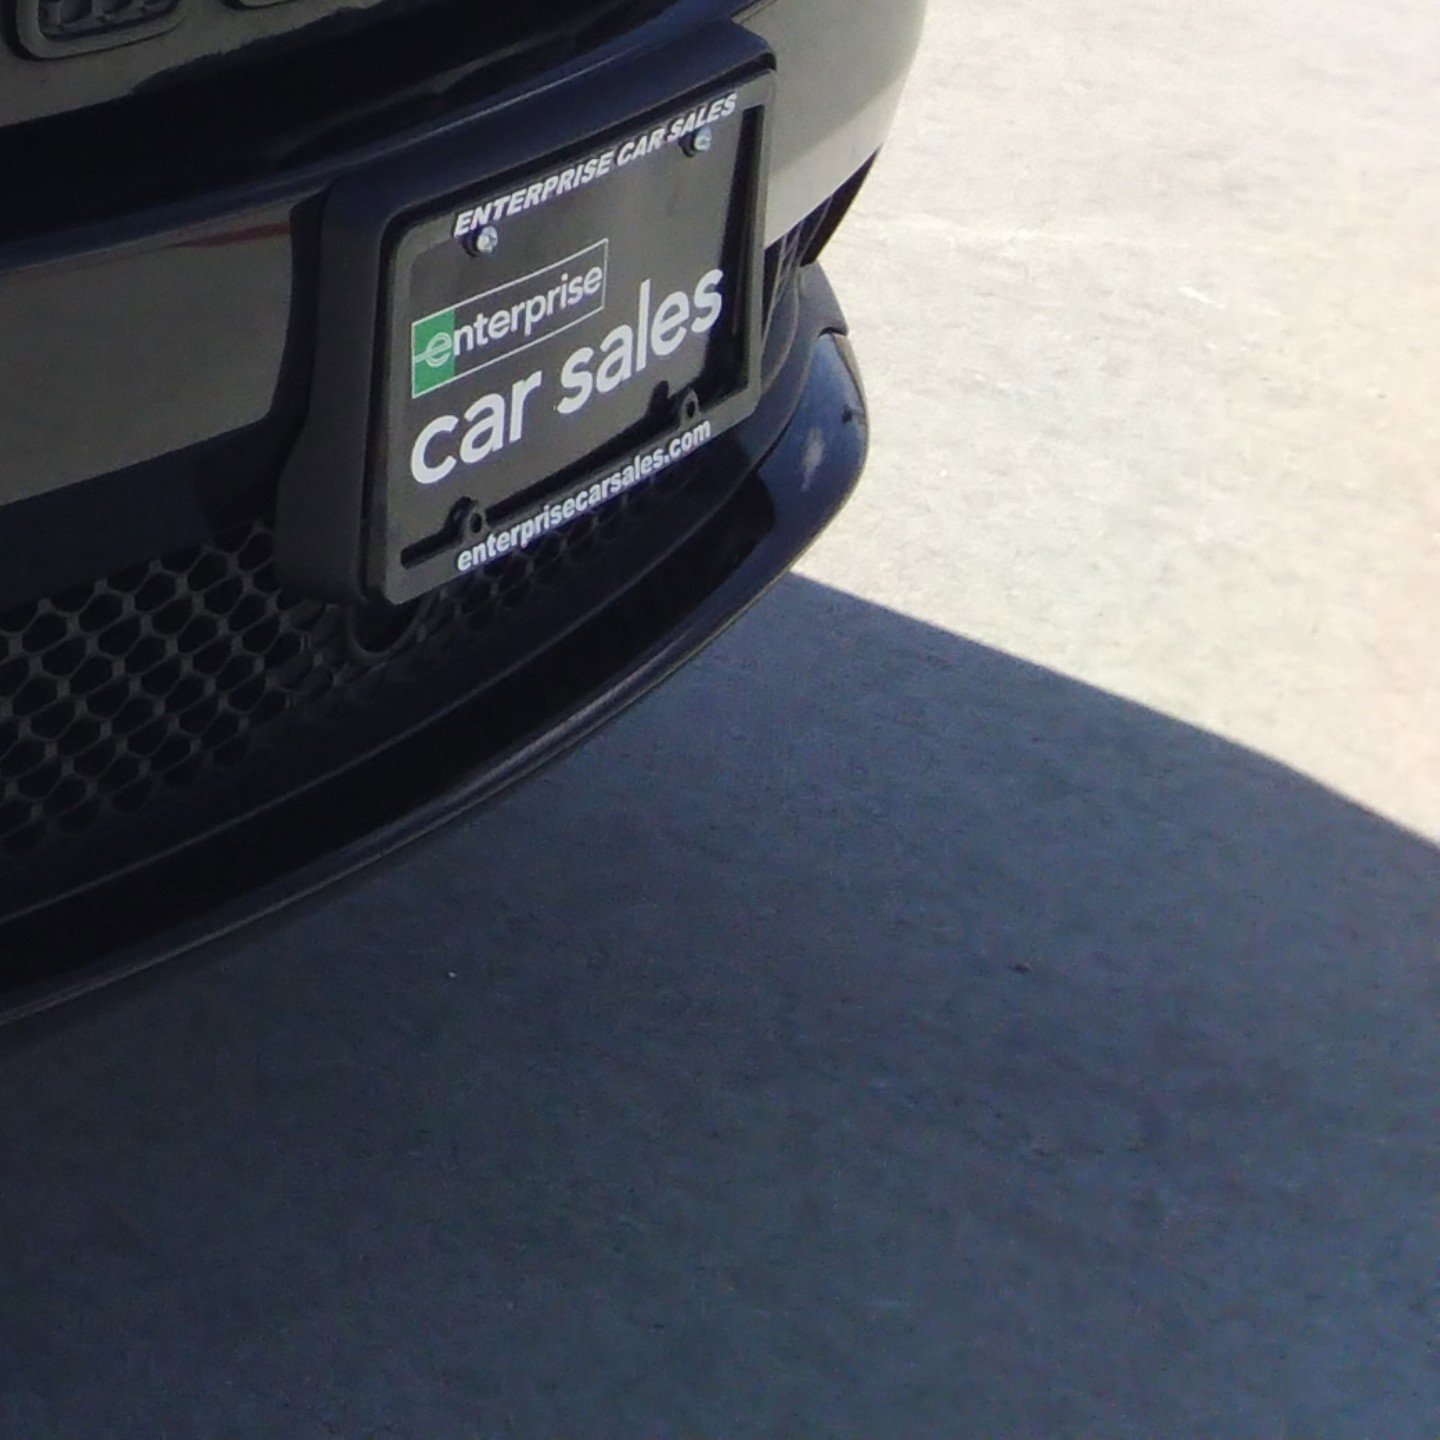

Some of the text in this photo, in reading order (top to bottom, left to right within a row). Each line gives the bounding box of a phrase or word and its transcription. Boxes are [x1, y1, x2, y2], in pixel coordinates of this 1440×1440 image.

[453, 93, 738, 238] ENTERPRISE CAR SALES
[411, 269, 723, 484] car sales
[415, 266, 602, 368] enterprise
[457, 420, 712, 572] enterprisecarsales.com
